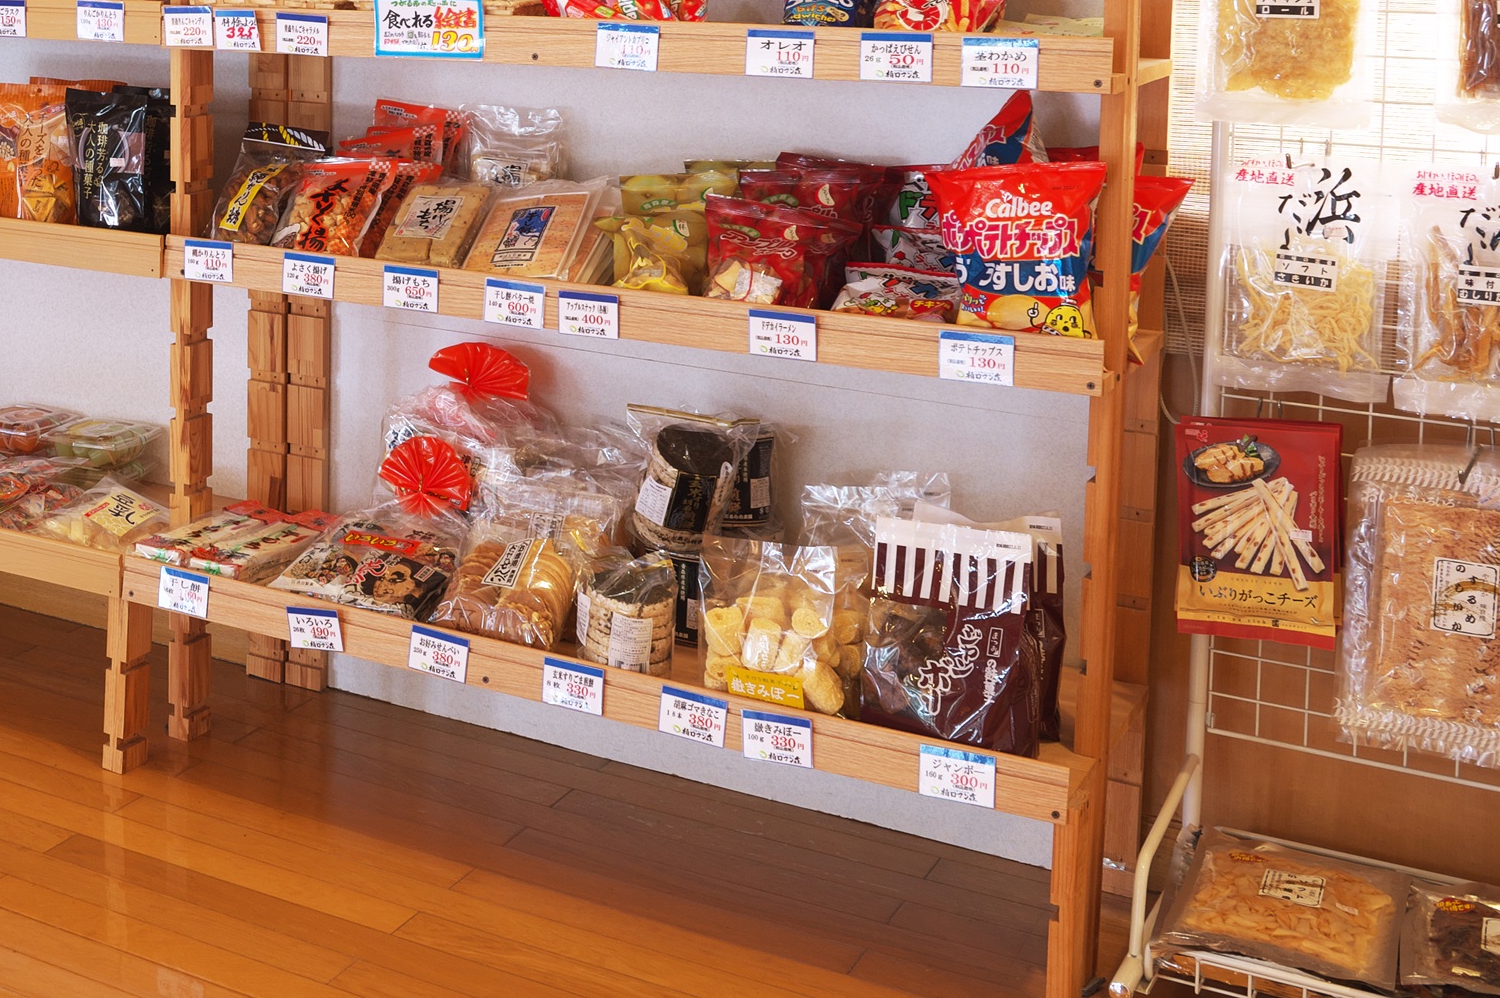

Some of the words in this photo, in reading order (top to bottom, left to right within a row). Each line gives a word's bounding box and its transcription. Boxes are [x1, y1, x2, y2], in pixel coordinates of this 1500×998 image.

[1262, 6, 1309, 15] ロール
[1, 16, 21, 25] 150円
[183, 27, 206, 36] 220円
[297, 36, 322, 45] 220円
[760, 40, 807, 51] オレオ
[871, 43, 922, 54] かっぱえびせん
[776, 51, 809, 62] 110円
[889, 54, 924, 65] 50円
[974, 51, 1027, 62] 茎わかめ
[993, 63, 1030, 75] 110円
[83, 121, 96, 199] 大人の種菓子
[1235, 169, 1295, 187] 産地直送
[1412, 183, 1478, 201] 産地直送
[985, 198, 1053, 218] Calbee
[1305, 167, 1361, 245] 浜
[191, 249, 226, 260] 縄かりんとう
[203, 259, 227, 269] 410円
[291, 264, 327, 275] よさく揚げ
[1282, 263, 1329, 275] ソフト
[304, 274, 329, 285] 380円
[392, 275, 430, 287] 揚げもち
[1276, 272, 1330, 288] さきいか
[405, 287, 433, 298] 650円
[507, 301, 536, 314] 600円
[582, 313, 611, 325] 400円
[775, 334, 808, 347] 130円
[951, 342, 1003, 357] ポテトチップス
[969, 356, 1006, 370] 130円
[1200, 584, 1319, 609] いぶりがっこチーズ
[295, 616, 332, 628] いろいろ
[310, 626, 336, 638] 490円
[419, 638, 460, 655] お好みせんべい
[432, 650, 460, 666] 380円
[566, 682, 596, 698] 330円
[673, 699, 719, 719] 胡麻ゴマきなこ
[688, 713, 721, 732] 380円
[770, 734, 804, 750] 330円
[932, 759, 985, 776] ジャンボー
[950, 773, 987, 790] 300円
